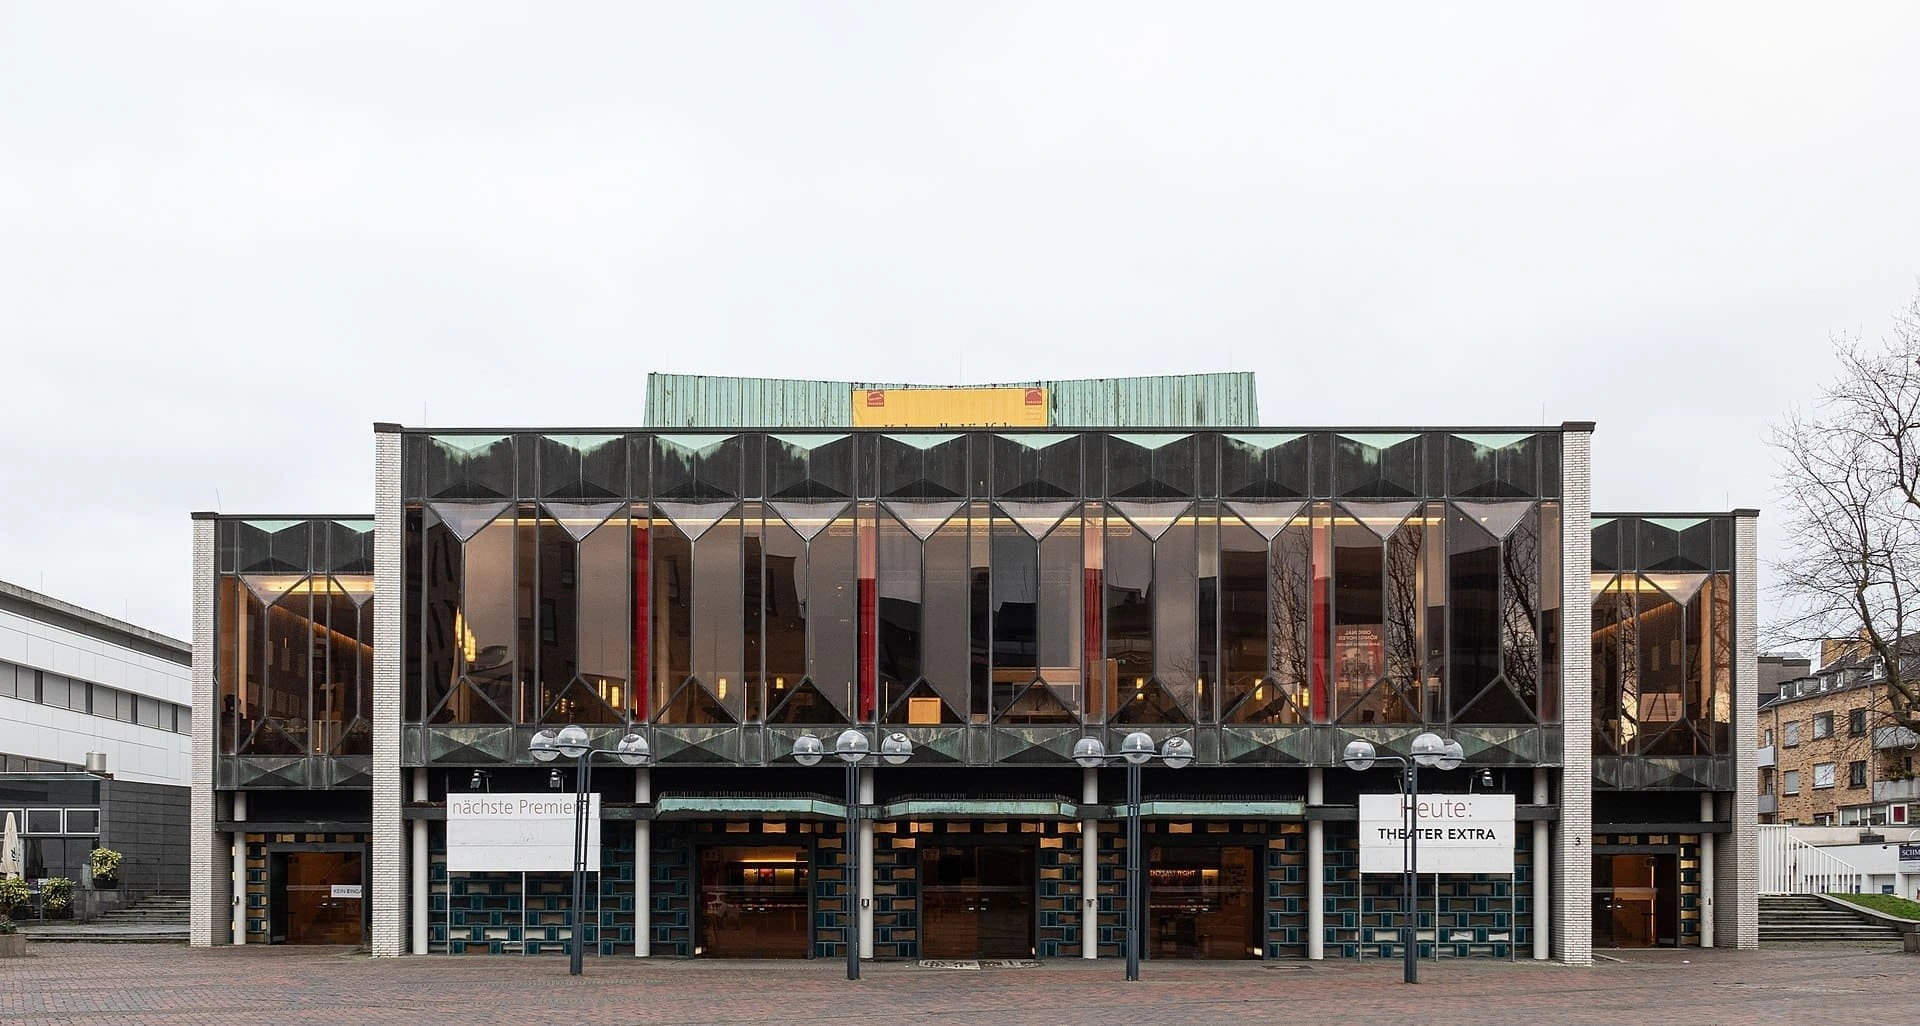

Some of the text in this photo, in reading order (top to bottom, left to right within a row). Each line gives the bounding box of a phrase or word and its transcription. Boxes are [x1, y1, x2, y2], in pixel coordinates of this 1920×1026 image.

[452, 798, 513, 815] nächste
[1378, 828, 1496, 840] THEATER EXTRA
[1575, 837, 1581, 846] 3
